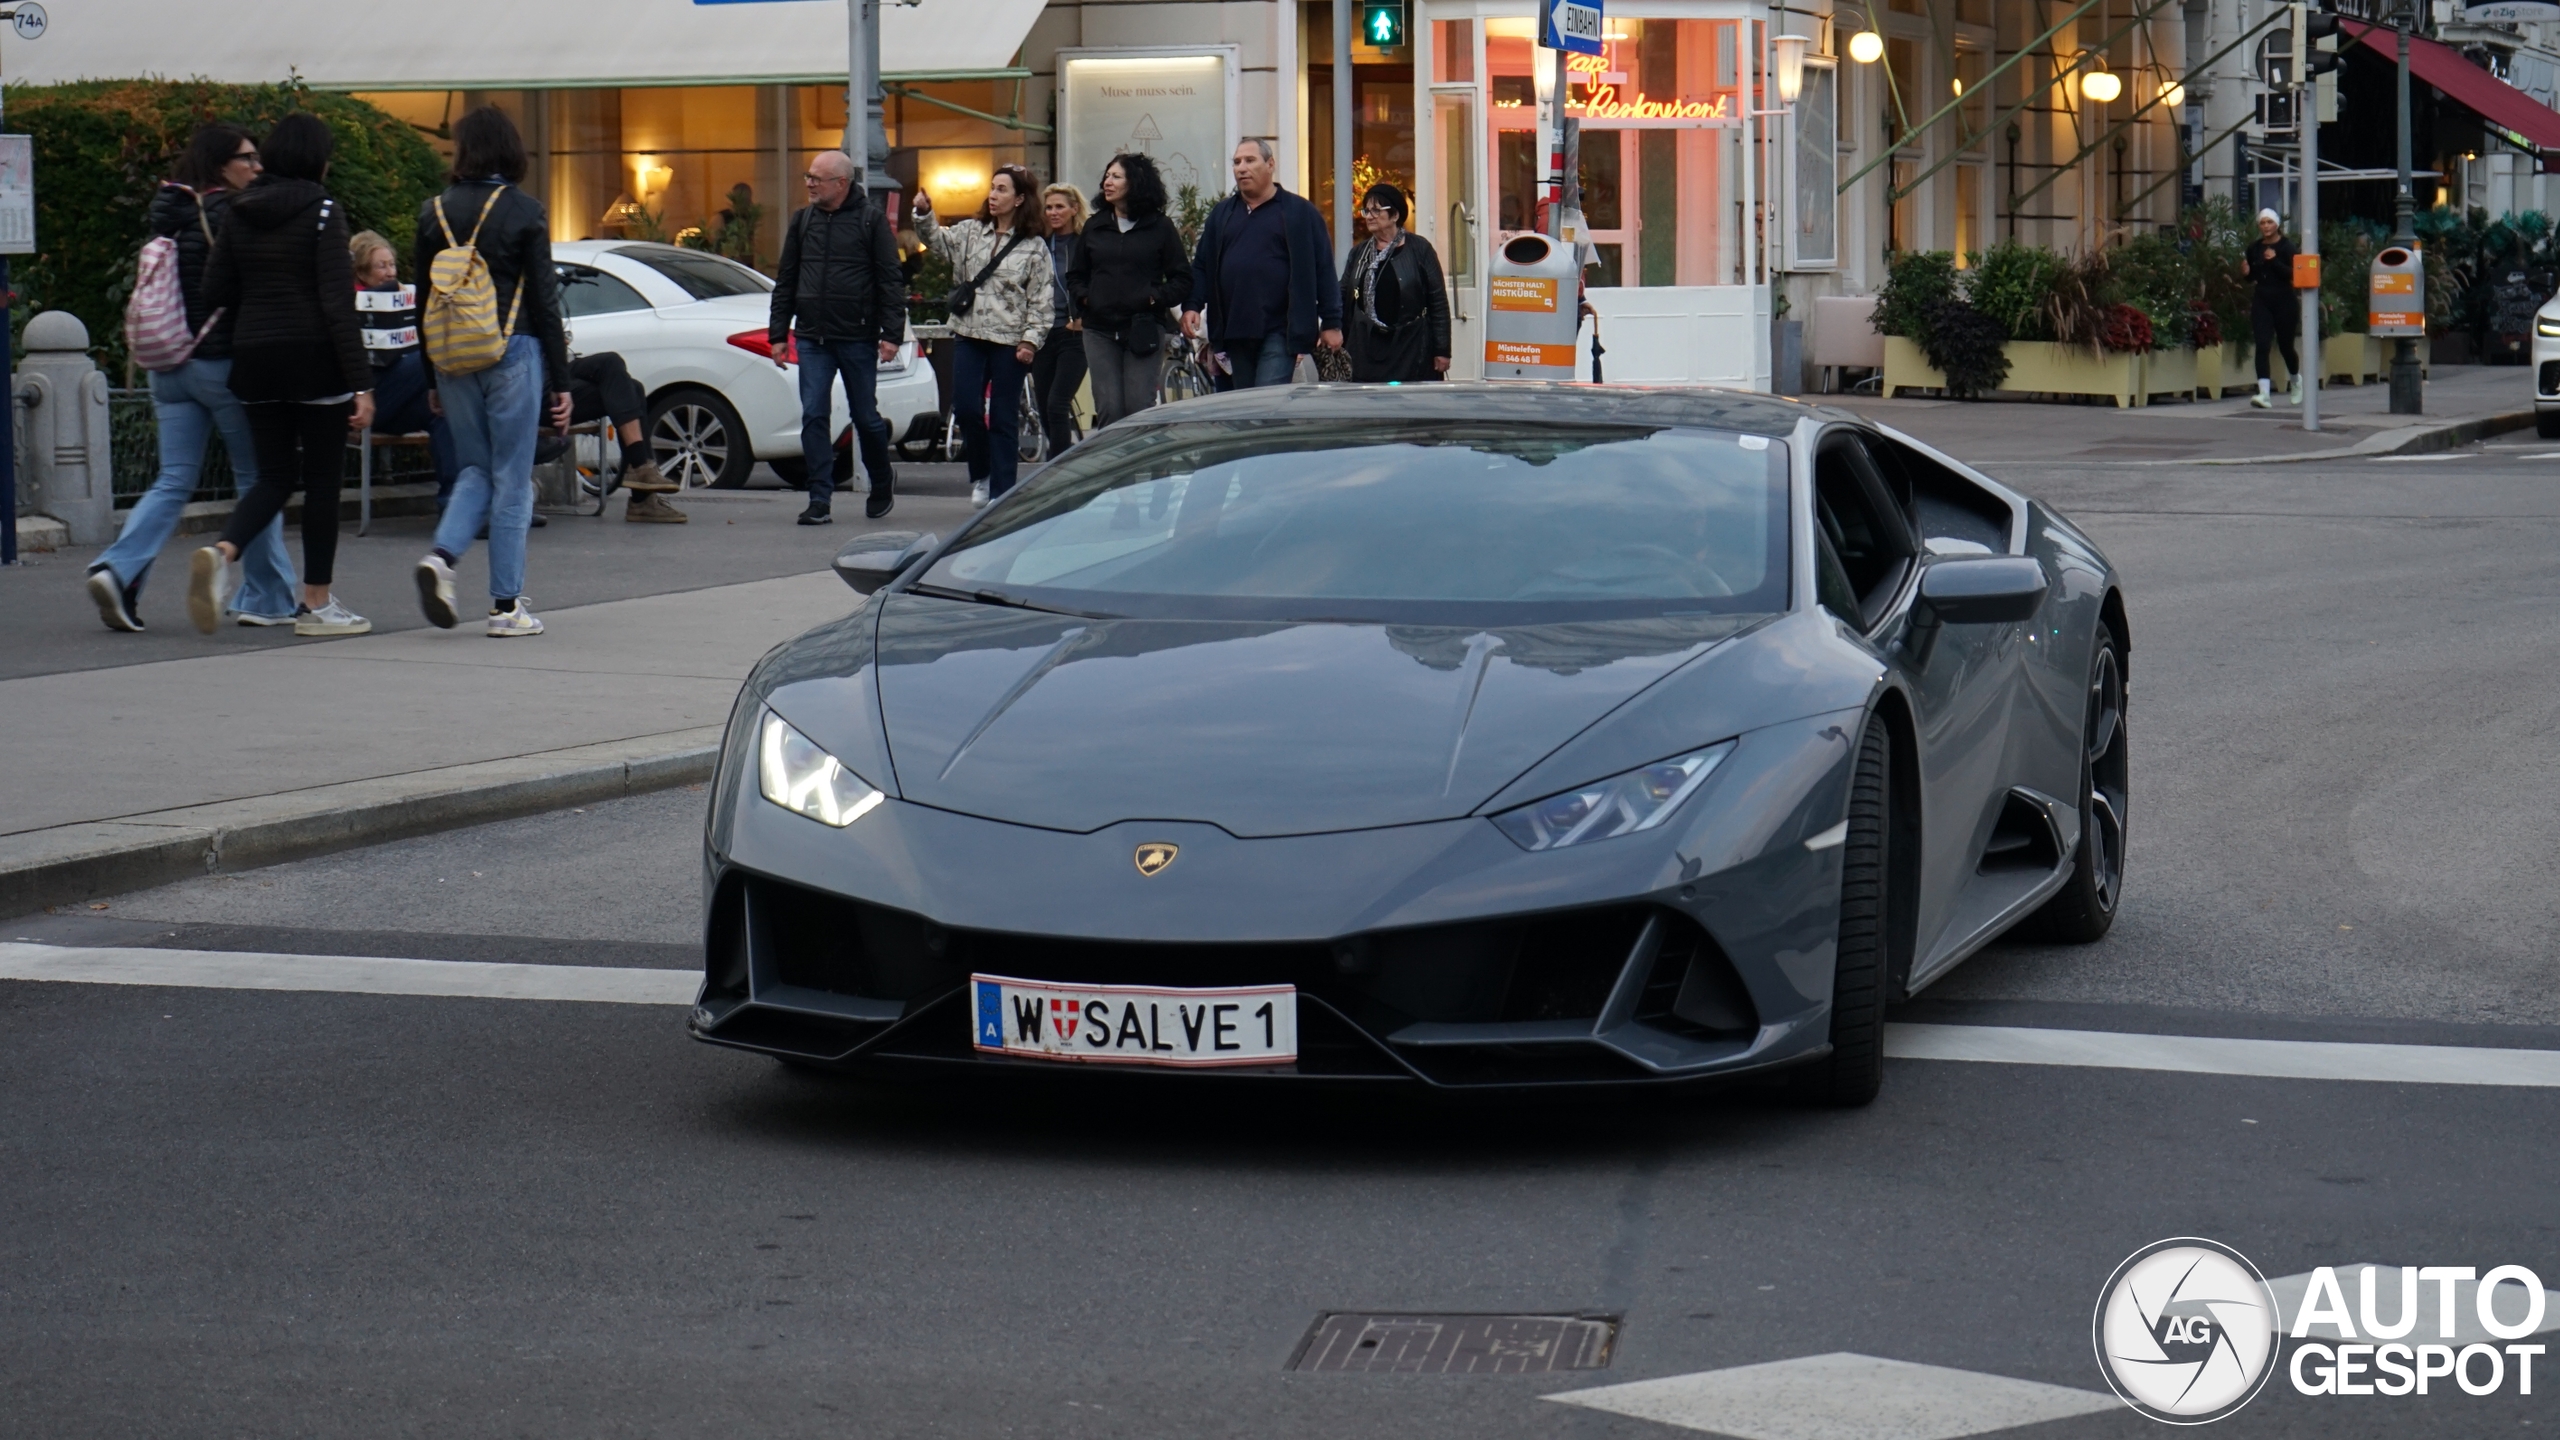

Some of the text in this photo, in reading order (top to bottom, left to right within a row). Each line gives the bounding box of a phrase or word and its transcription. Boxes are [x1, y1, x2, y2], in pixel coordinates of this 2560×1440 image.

[16, 13, 43, 28] 74A
[1567, 6, 1598, 37] EINBAHN
[1101, 85, 1196, 98] Muse muss sein.
[1587, 83, 1727, 118] Restaurant
[1493, 288, 1542, 298] MISTKÜBEL.
[1498, 344, 1541, 353] Misttelefon
[1506, 354, 1520, 362] 546
[986, 1022, 997, 1037] A
[1013, 995, 1274, 1052] W SALVE 1
